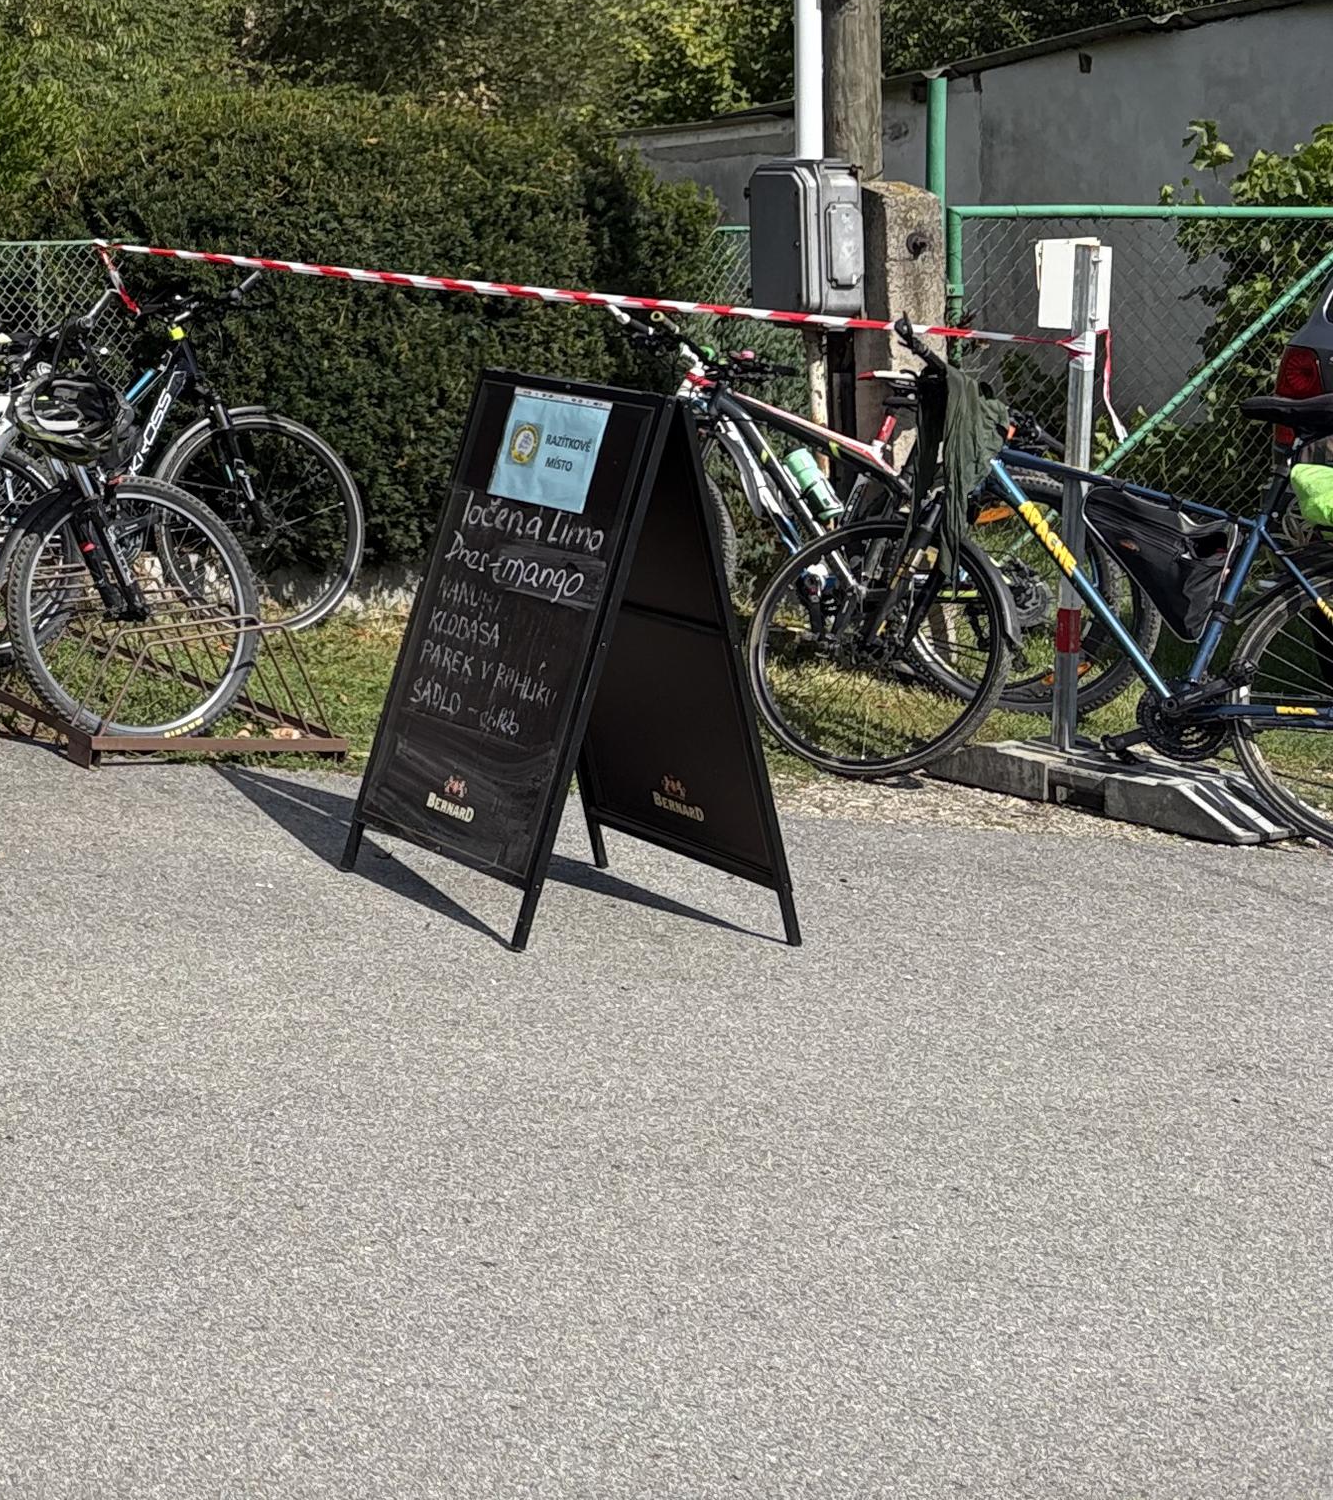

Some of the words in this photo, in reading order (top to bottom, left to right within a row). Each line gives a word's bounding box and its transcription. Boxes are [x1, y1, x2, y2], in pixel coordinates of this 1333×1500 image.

[128, 388, 172, 477] KROSS
[545, 434, 593, 453] RAZÍTKOVÉ
[544, 456, 573, 472] MÍSTO
[1018, 500, 1077, 577] APACHE
[425, 791, 475, 823] BERNARD
[651, 790, 705, 822] BERNARD
